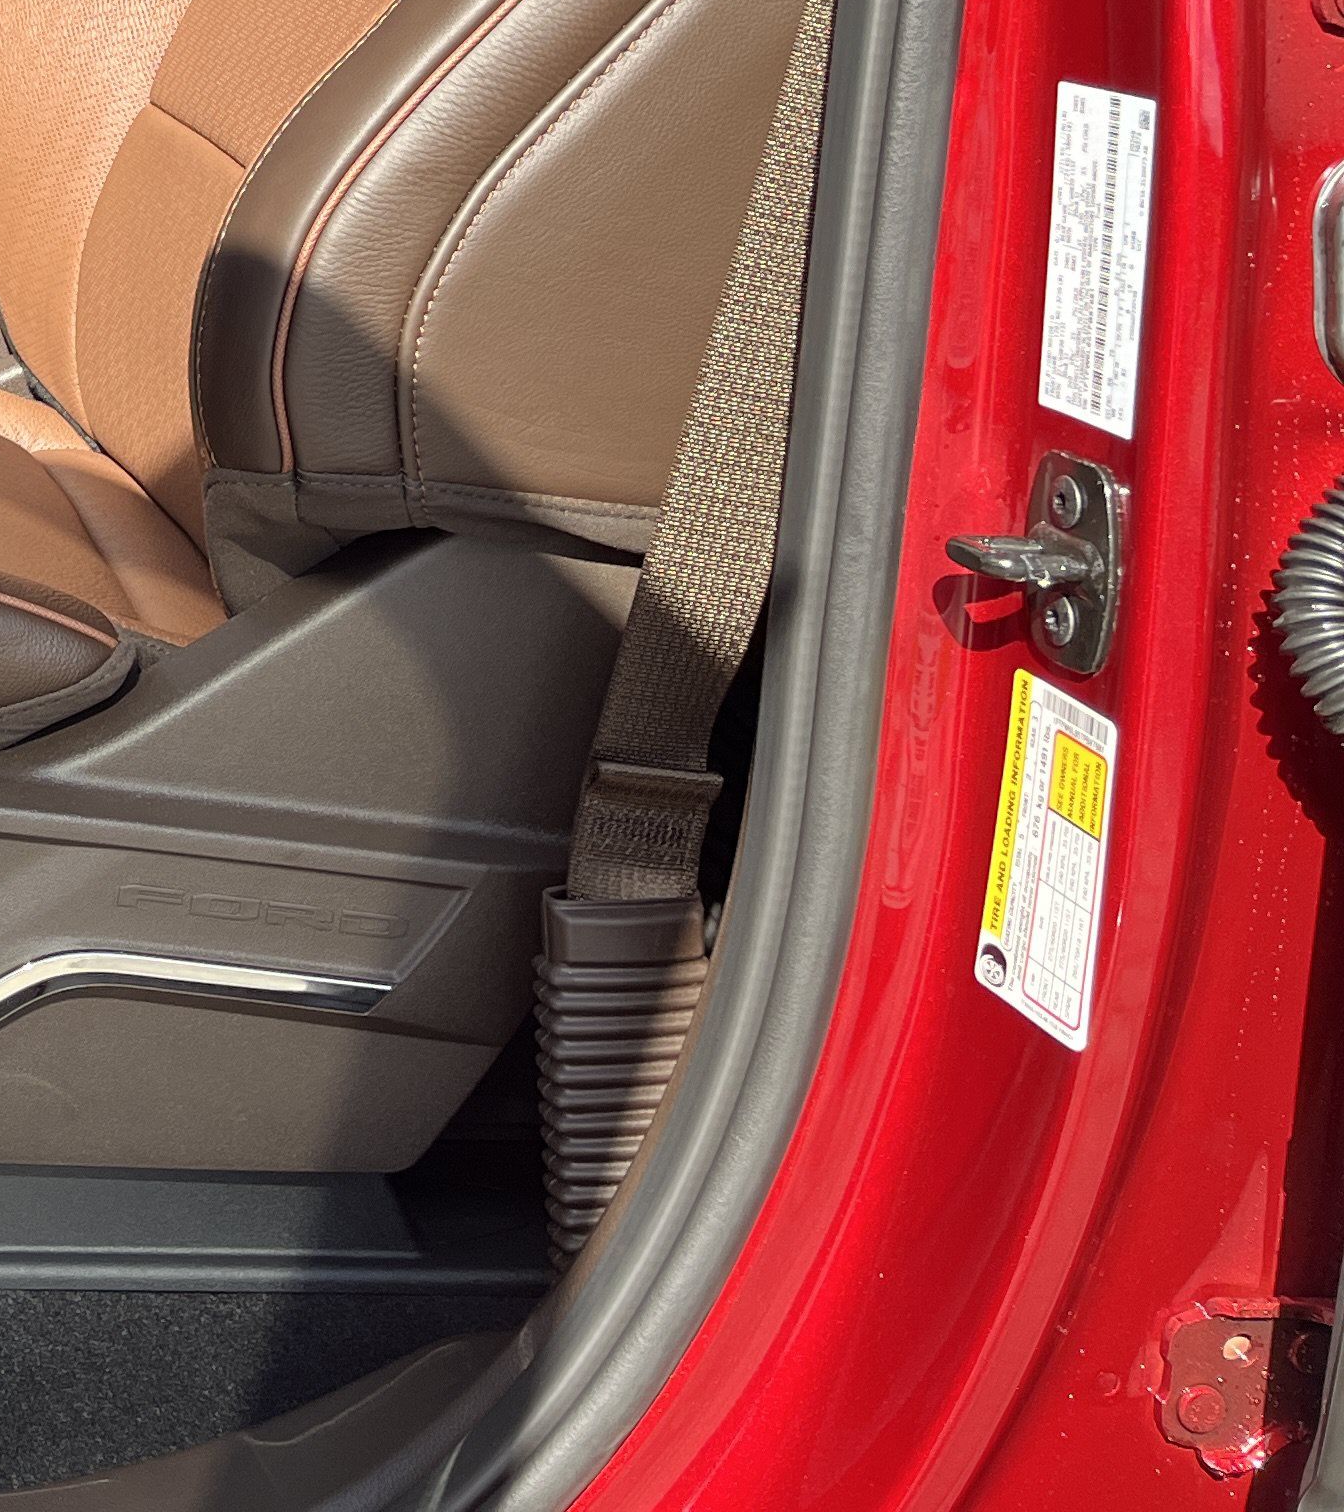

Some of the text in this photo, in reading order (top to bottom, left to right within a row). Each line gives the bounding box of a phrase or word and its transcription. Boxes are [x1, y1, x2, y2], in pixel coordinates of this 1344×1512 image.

[990, 679, 1029, 931] TIRE AND LOADING INFORMATION
[115, 883, 410, 940] FORD
